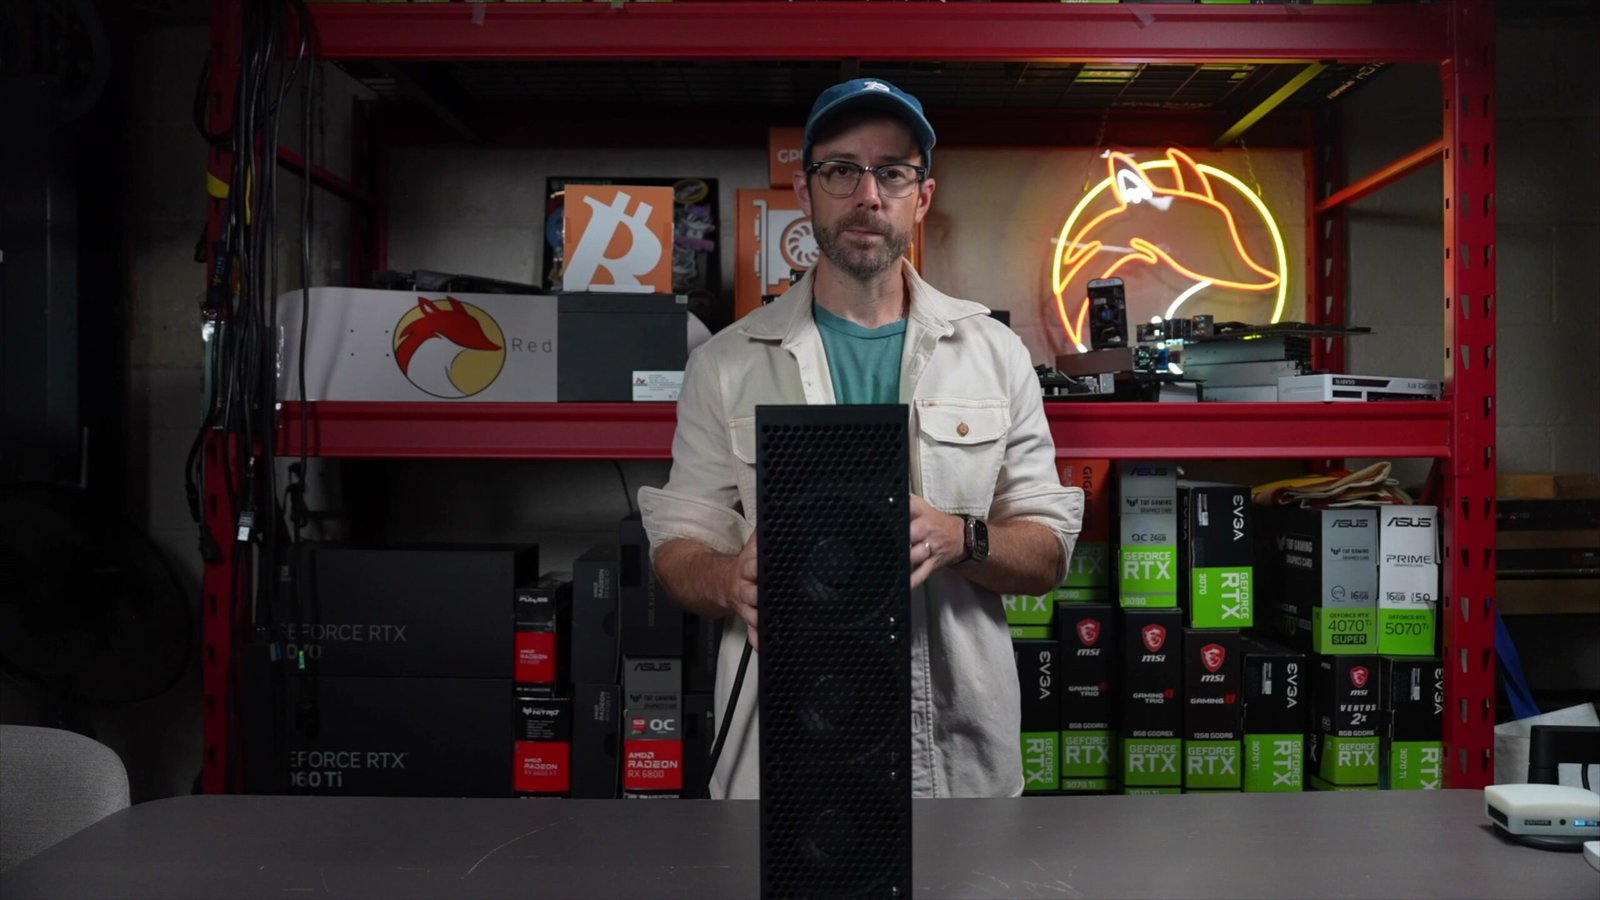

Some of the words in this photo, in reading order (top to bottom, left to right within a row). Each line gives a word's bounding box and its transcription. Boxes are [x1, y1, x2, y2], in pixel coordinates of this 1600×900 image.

[511, 337, 553, 353] Red
[1129, 466, 1168, 477] ASUS
[1232, 494, 1245, 541] EVGA
[1331, 519, 1368, 528] ASUS
[1387, 517, 1432, 528] ASUS
[1131, 533, 1148, 542] OC
[1123, 551, 1171, 561] GEFORCE
[1385, 554, 1433, 565] PRIME
[1071, 556, 1104, 574] TX
[1123, 561, 1172, 580] RTX
[1001, 594, 1048, 612] RTX
[1220, 572, 1241, 620] RTX
[1239, 572, 1249, 620] GEFORCE
[368, 624, 407, 642] RTX
[1327, 619, 1365, 633] 4070
[1385, 622, 1422, 635] 5070
[1332, 634, 1366, 645] SUPER
[1076, 647, 1101, 656] msi
[1141, 654, 1167, 663] msi
[633, 662, 672, 672] ASUS
[1038, 650, 1052, 700] EVGA
[1200, 674, 1226, 683] msi
[1286, 662, 1298, 709] EVGA
[1433, 667, 1444, 715] EVGA
[1350, 689, 1368, 697] msi
[1189, 697, 1225, 705] GAMING
[1339, 703, 1377, 712] VENTUS
[649, 718, 675, 731] OC
[1128, 744, 1177, 753] GEFORCE
[1187, 746, 1236, 756] GEFORCE
[1338, 742, 1376, 751] GEFORCE
[367, 751, 406, 769] RTX
[1025, 738, 1045, 784] RTX
[1044, 737, 1054, 784] GEFORCE
[1065, 746, 1112, 764] RTX
[1338, 750, 1376, 767] RTX
[523, 762, 558, 770] RADEON
[627, 760, 678, 769] RADEON
[1128, 753, 1177, 773] RTX
[1187, 756, 1236, 775] RTX
[1272, 740, 1292, 786] RTX
[1291, 741, 1300, 787] GEFORCE
[1419, 747, 1440, 790] RTX
[323, 769, 343, 788] Ti
[627, 770, 640, 778] RX
